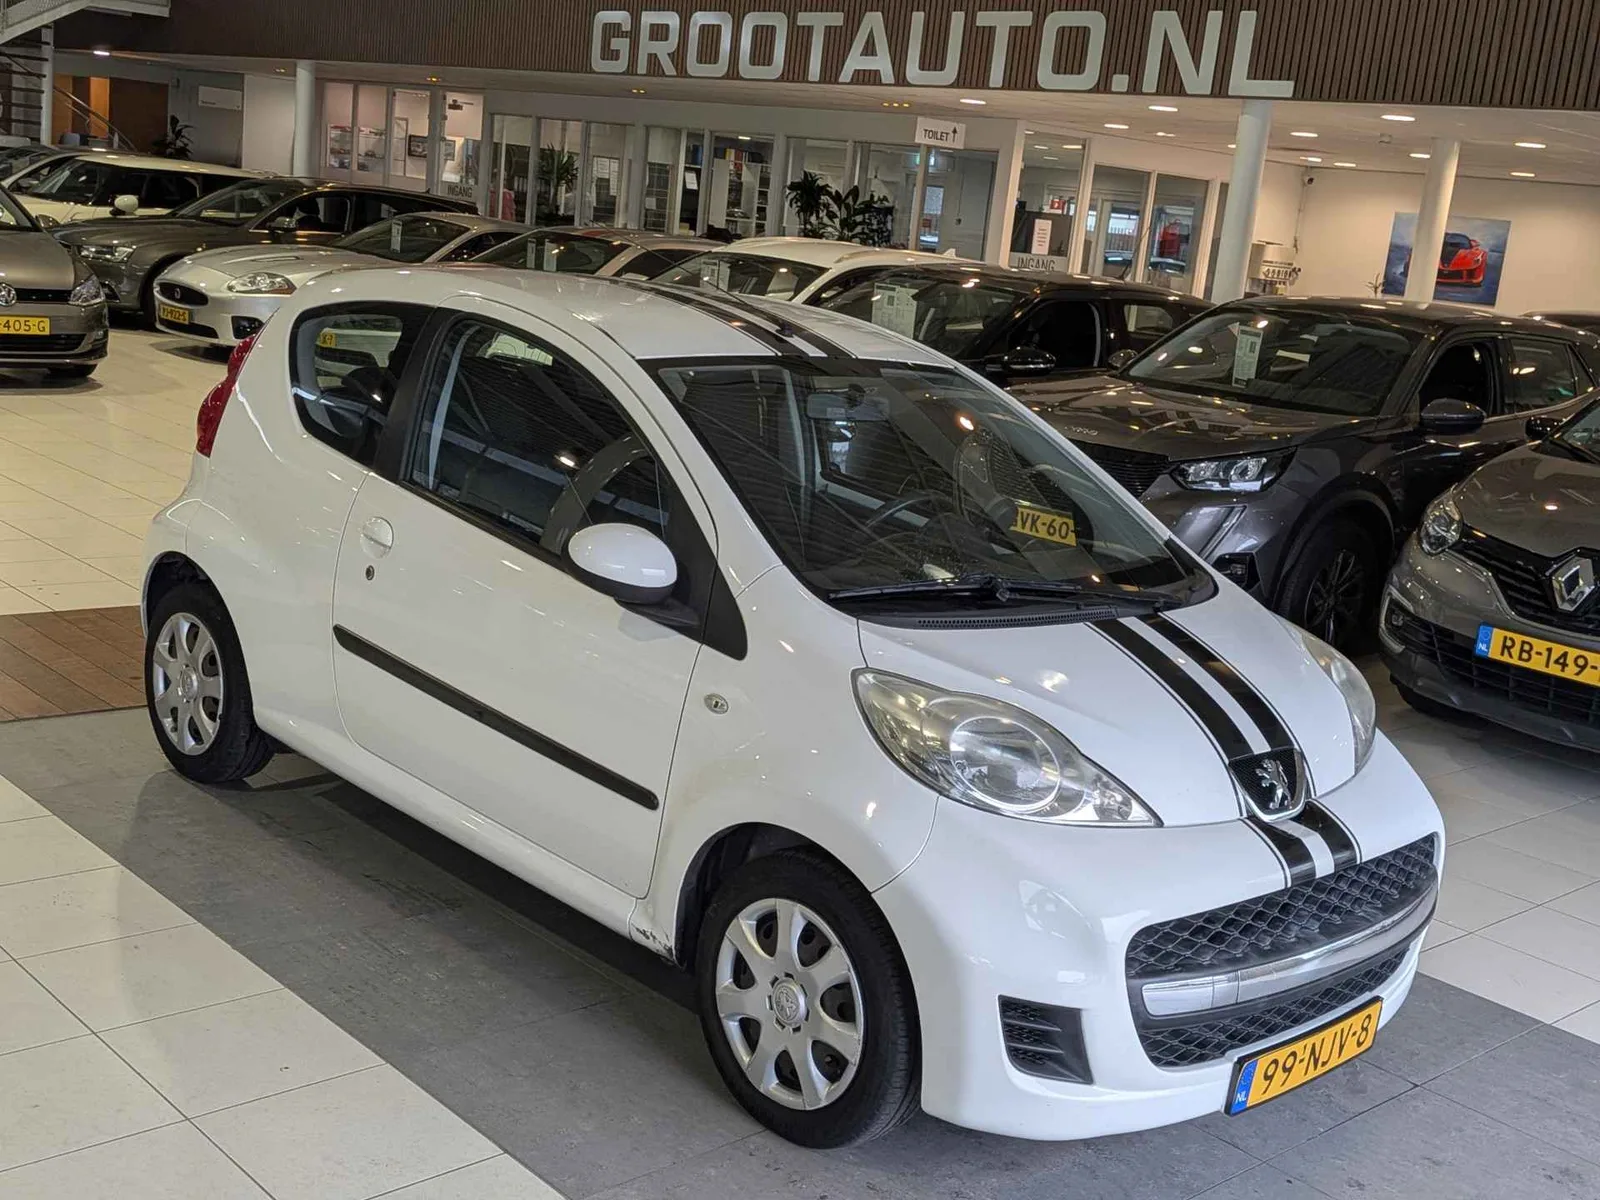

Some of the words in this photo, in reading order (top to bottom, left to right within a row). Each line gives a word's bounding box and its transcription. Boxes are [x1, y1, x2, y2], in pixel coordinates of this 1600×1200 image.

[591, 10, 1295, 98] GROOTAUTO.NL
[923, 128, 950, 141] TOILET
[447, 184, 473, 198] INGANG
[1017, 256, 1056, 272] INGANG
[1477, 642, 1488, 652] NL
[1500, 635, 1600, 682] RB-149-
[1235, 1092, 1247, 1104] NL
[1262, 1013, 1372, 1096] 99-NJV-8
